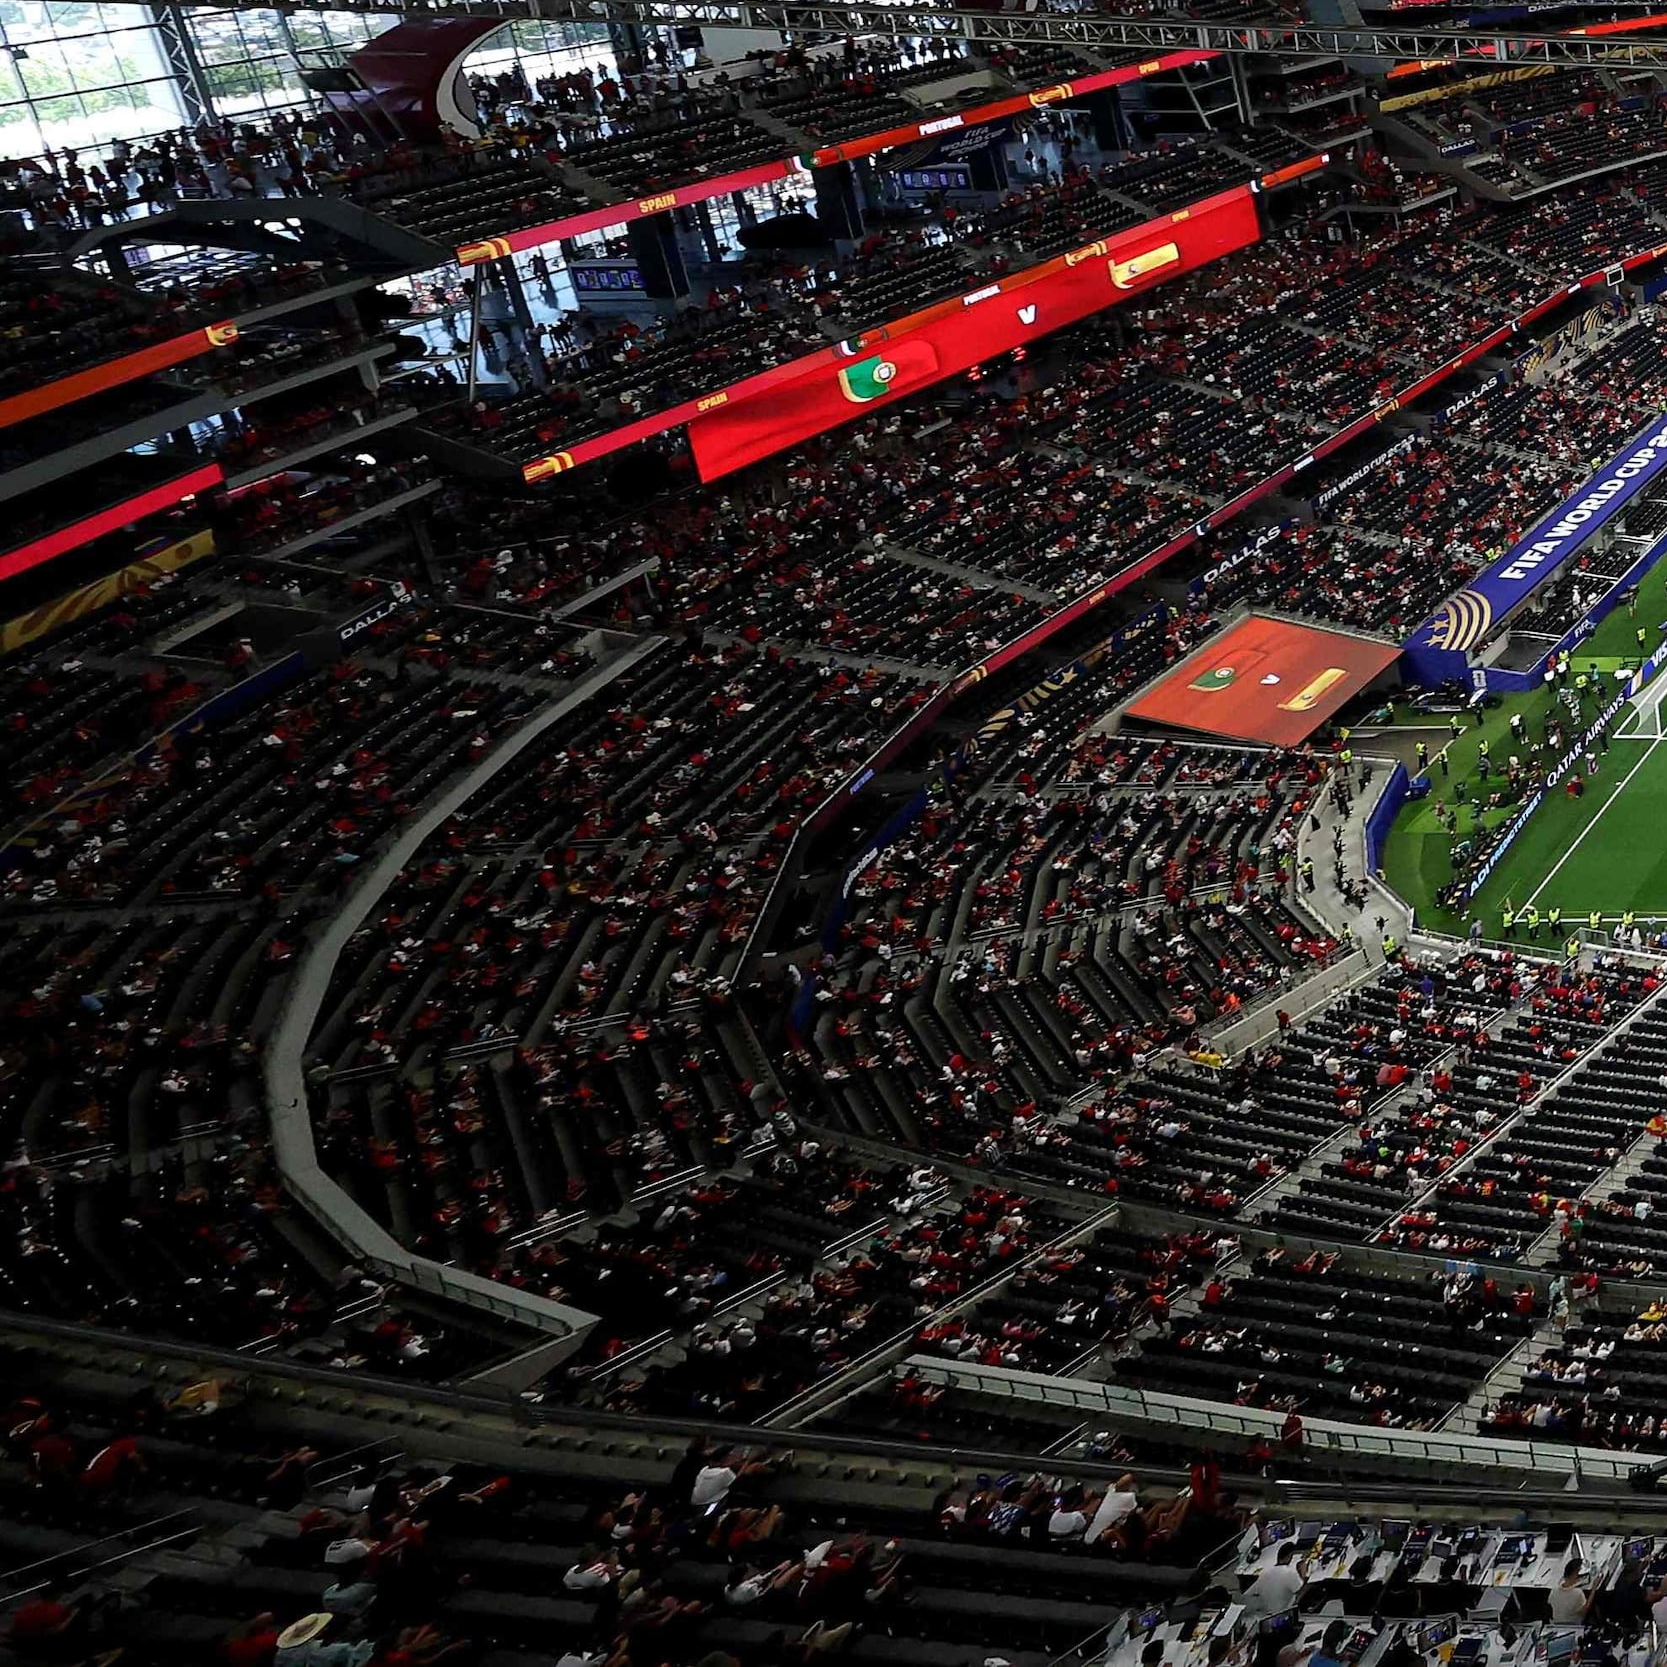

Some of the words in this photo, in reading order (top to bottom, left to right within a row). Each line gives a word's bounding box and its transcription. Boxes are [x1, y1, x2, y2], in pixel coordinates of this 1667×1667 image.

[639, 193, 676, 214] SPAIN
[1445, 375, 1498, 418] DALLAS
[1318, 488, 1338, 506] FIFA
[1338, 465, 1371, 492] WORLD
[1370, 452, 1387, 471] CUP
[1498, 539, 1563, 580] FIFA
[1544, 479, 1625, 538] WORLD
[1614, 447, 1657, 479] CUP
[1202, 525, 1282, 584] DALLAS
[1546, 741, 1583, 788] QATAR
[1584, 693, 1626, 746] AIRWAYS
[1469, 862, 1491, 898] ADI
